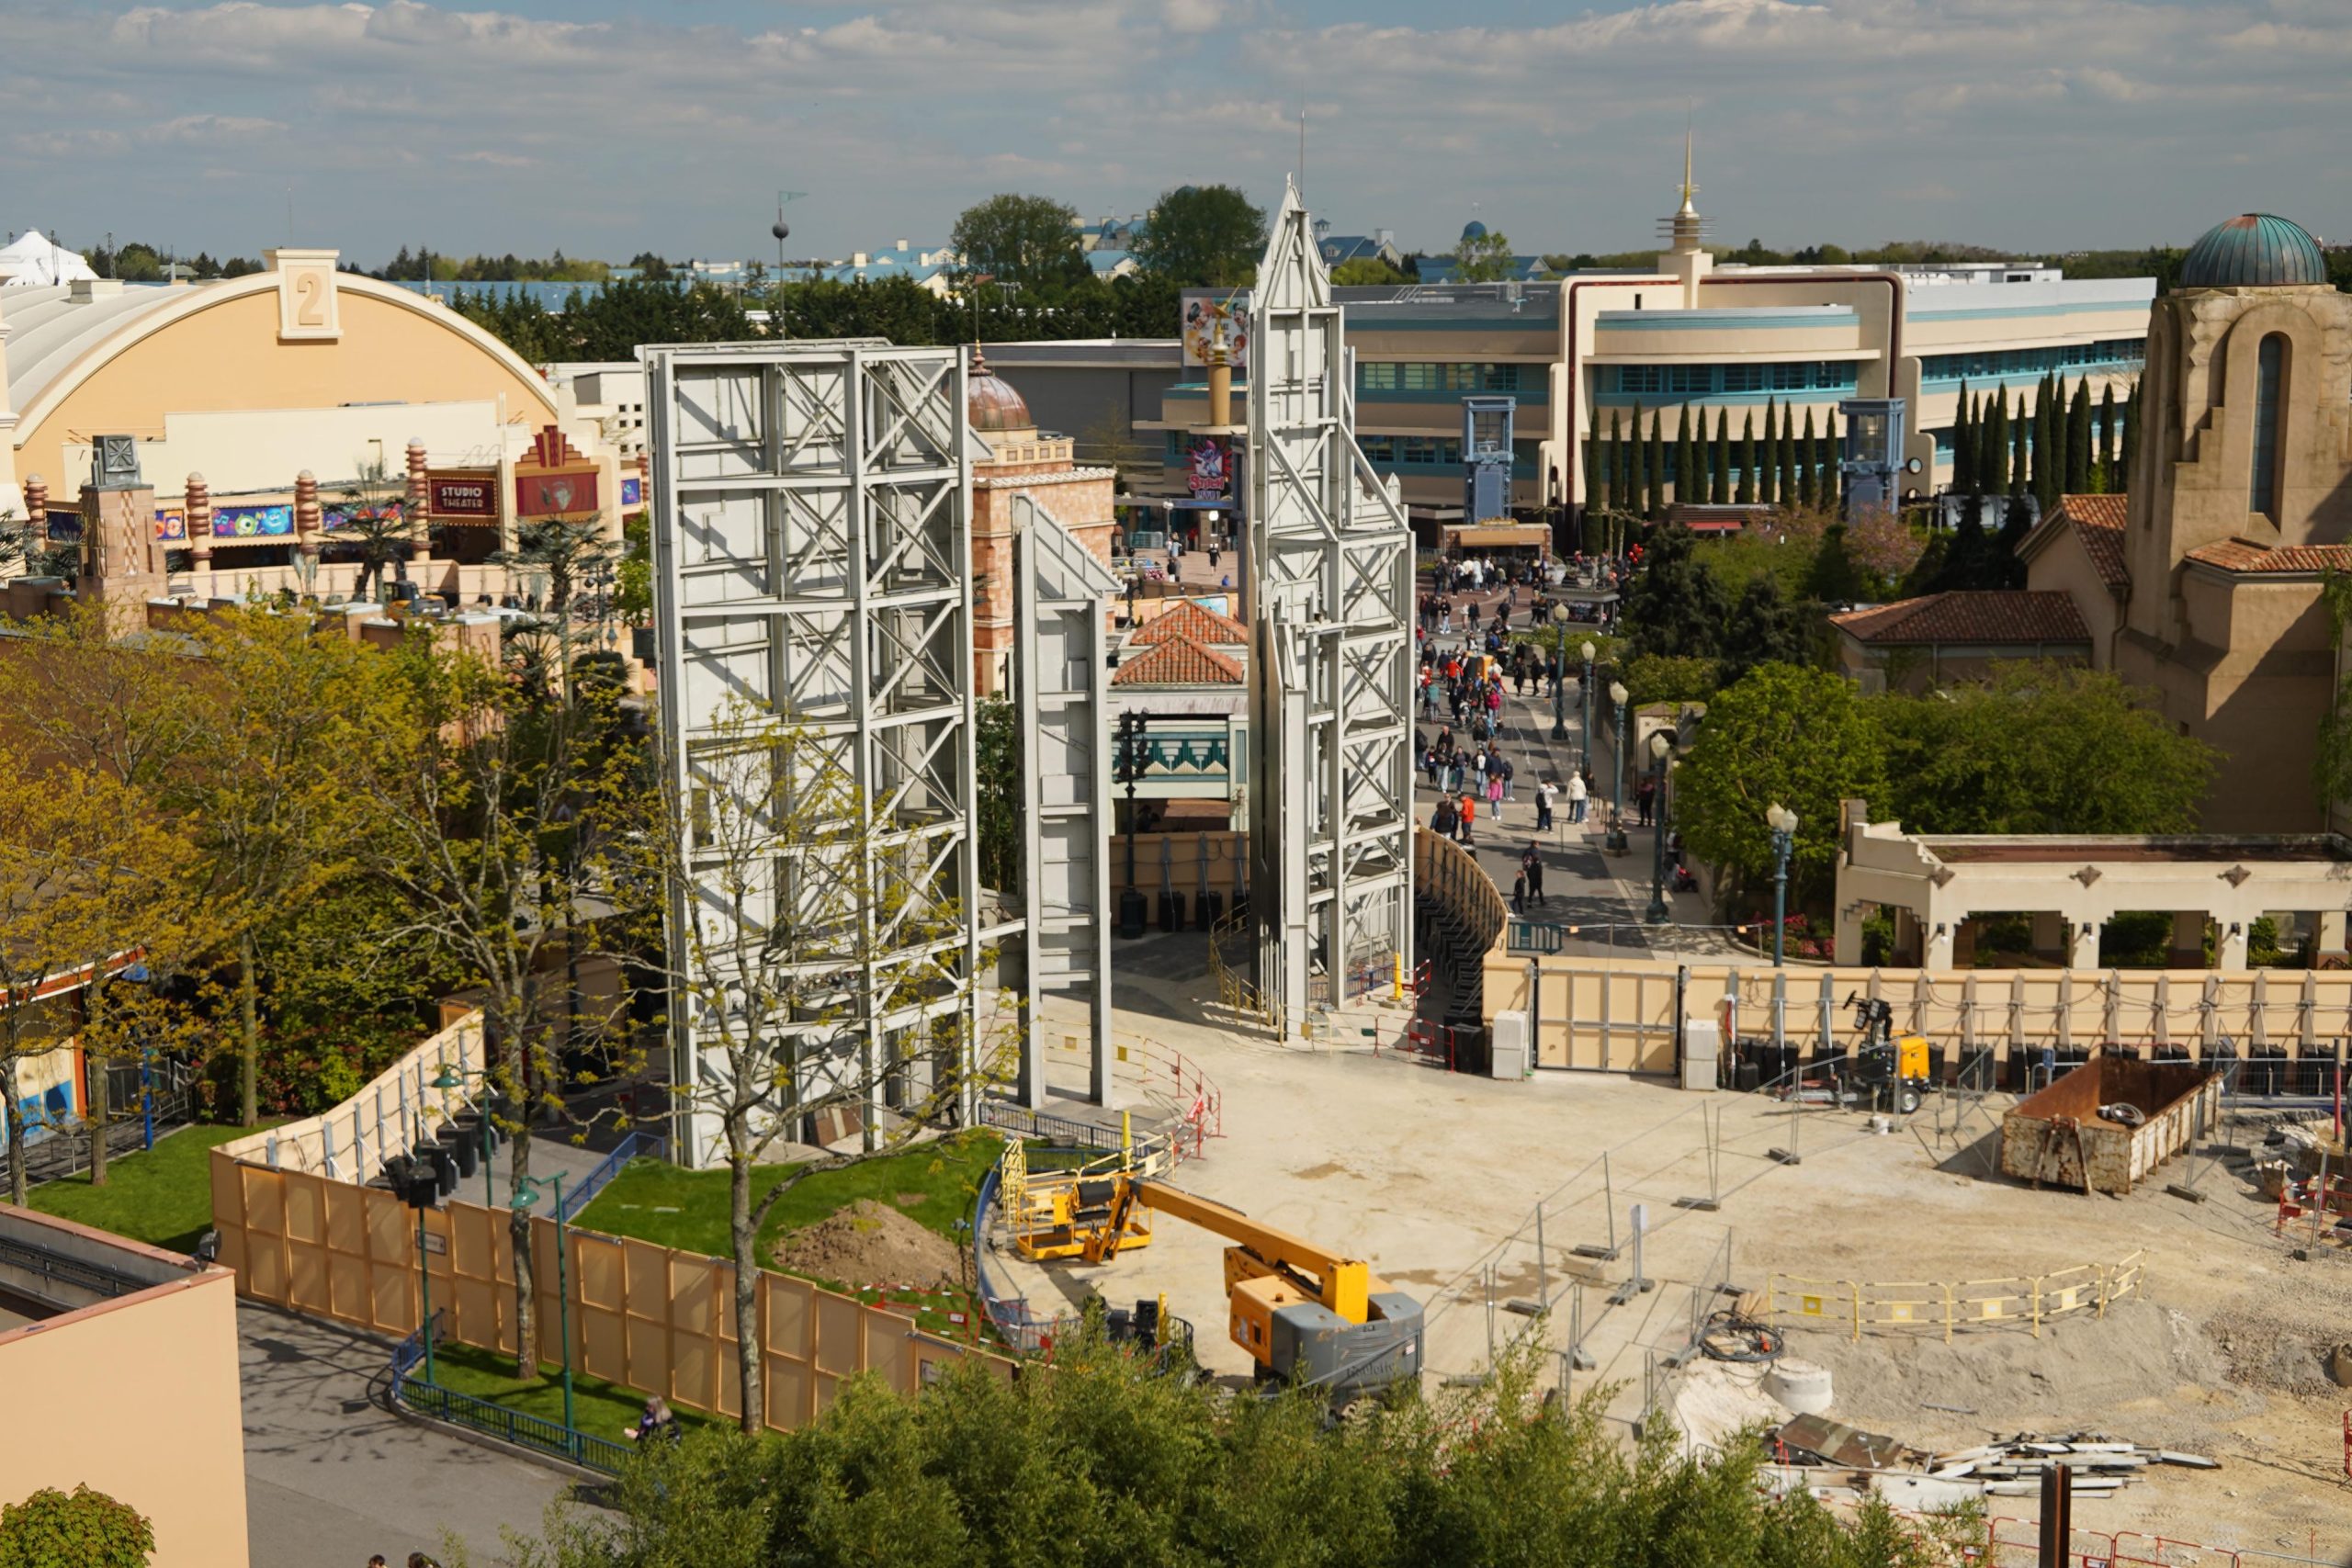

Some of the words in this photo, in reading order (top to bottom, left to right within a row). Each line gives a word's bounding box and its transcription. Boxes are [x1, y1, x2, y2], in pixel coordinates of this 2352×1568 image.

[296, 272, 323, 325] 2
[441, 487, 482, 497] STUDIO
[442, 498, 483, 508] THEATER
